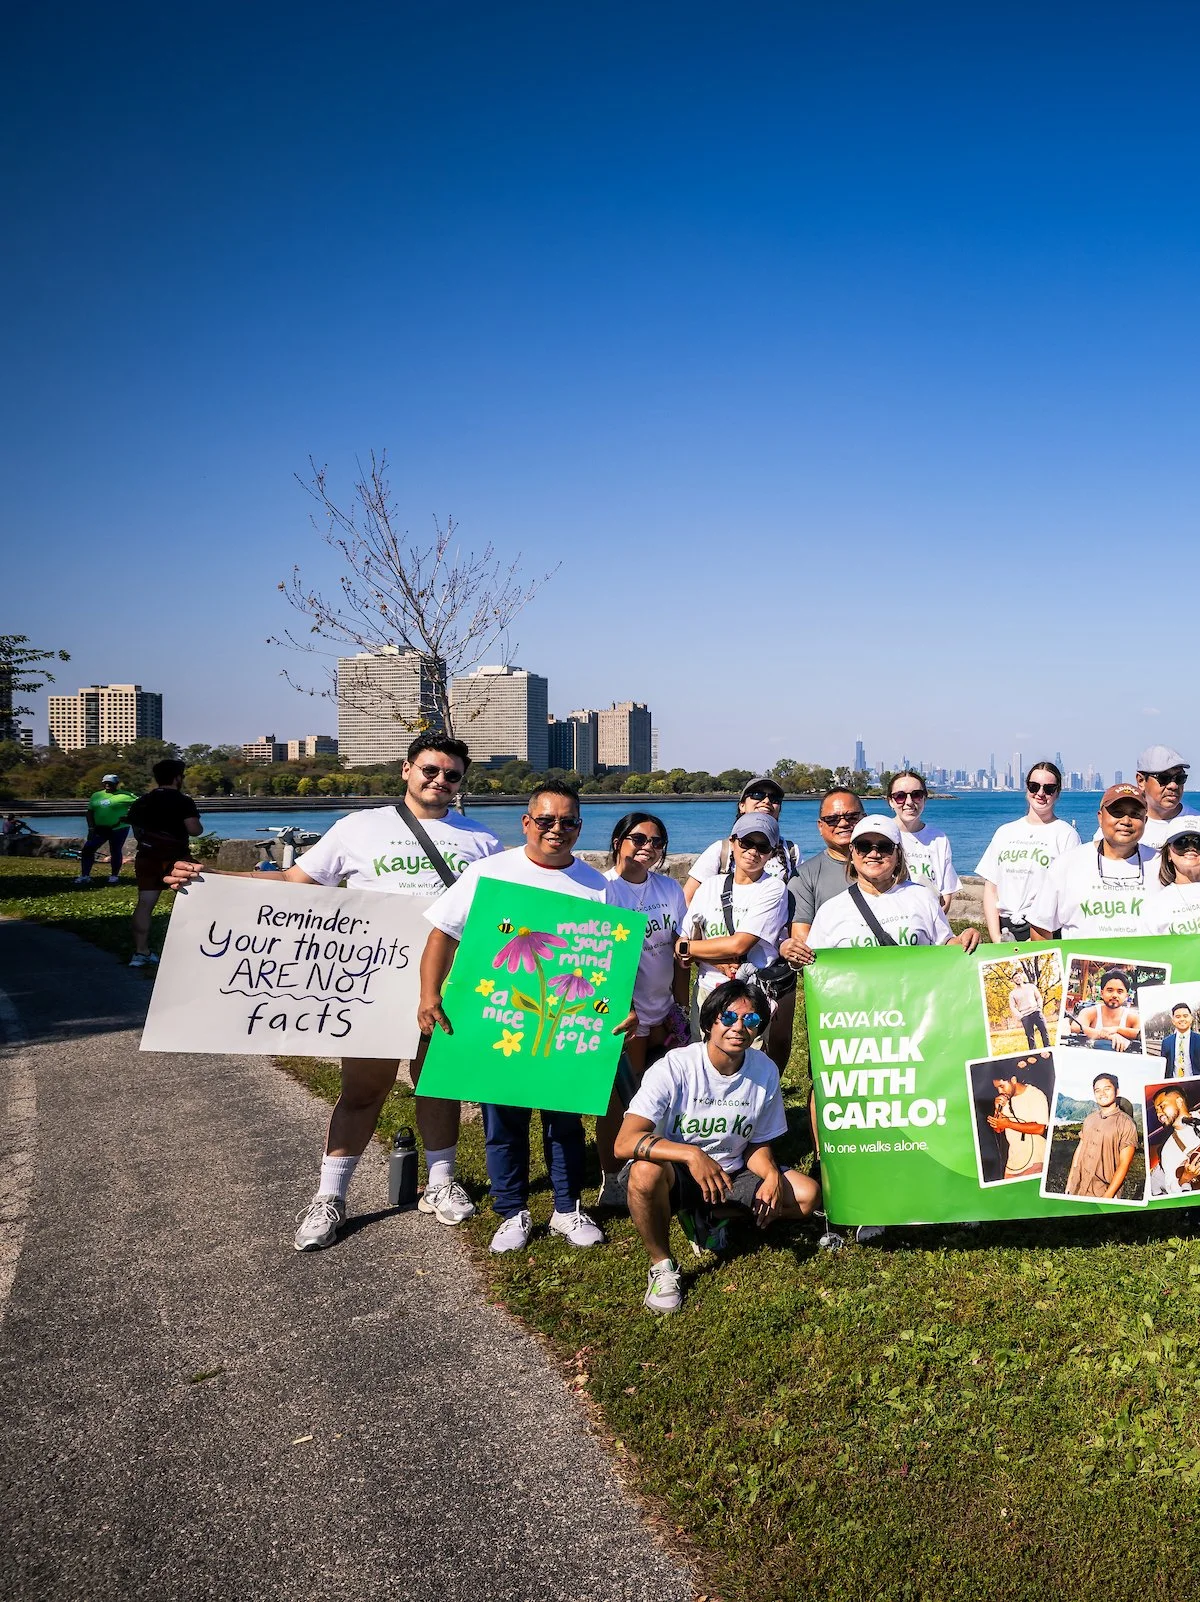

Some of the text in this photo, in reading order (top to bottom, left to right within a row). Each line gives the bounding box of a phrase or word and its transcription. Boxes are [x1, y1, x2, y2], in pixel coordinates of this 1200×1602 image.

[373, 854, 436, 877] Kaya
[998, 849, 1029, 866] Kaya
[1080, 898, 1127, 918] Kaya
[257, 904, 370, 935] Reminder:
[557, 919, 611, 937] make
[645, 919, 662, 939] ya
[571, 935, 614, 952] your
[294, 933, 410, 977] thoughts
[558, 950, 613, 972] mind
[228, 958, 299, 989] ARE
[490, 990, 509, 1006] a
[247, 1002, 352, 1038] facts
[482, 1006, 524, 1029] nice
[560, 1014, 604, 1032] place
[819, 1010, 906, 1029] KAYA KO.
[555, 1030, 600, 1055] to be
[819, 1036, 925, 1066] WALK
[820, 1068, 916, 1098] WITH
[704, 1098, 740, 1107] CHICAGO
[822, 1098, 947, 1131] CARLO!
[672, 1114, 727, 1138] Kaya
[824, 1140, 929, 1153] No one walks alone.
